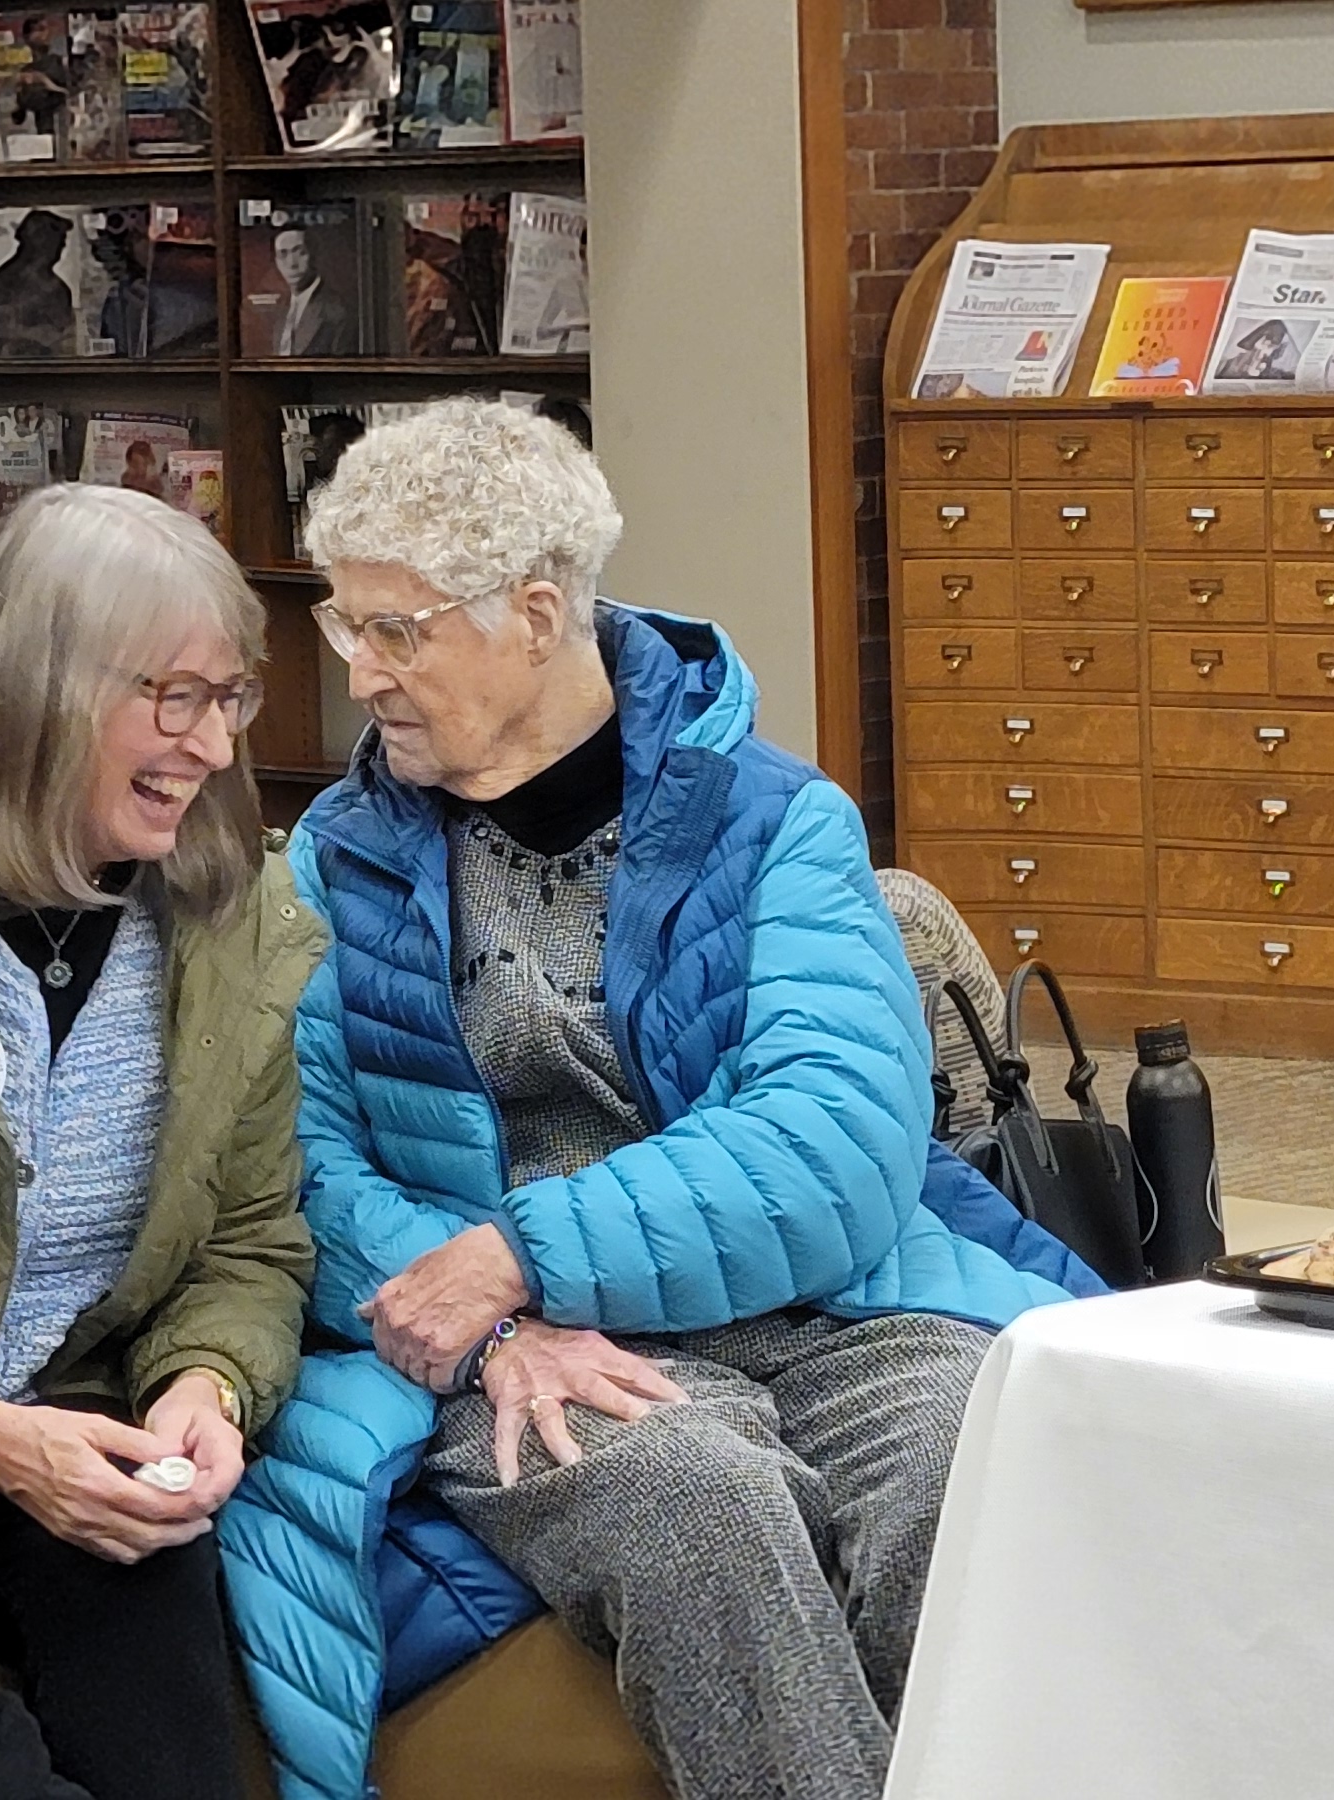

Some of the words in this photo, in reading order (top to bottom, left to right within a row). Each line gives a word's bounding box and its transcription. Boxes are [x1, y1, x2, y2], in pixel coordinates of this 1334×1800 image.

[1010, 297, 1061, 313] Gazette
[1143, 307, 1187, 319] SEED
[1122, 320, 1200, 331] LIBRARY
